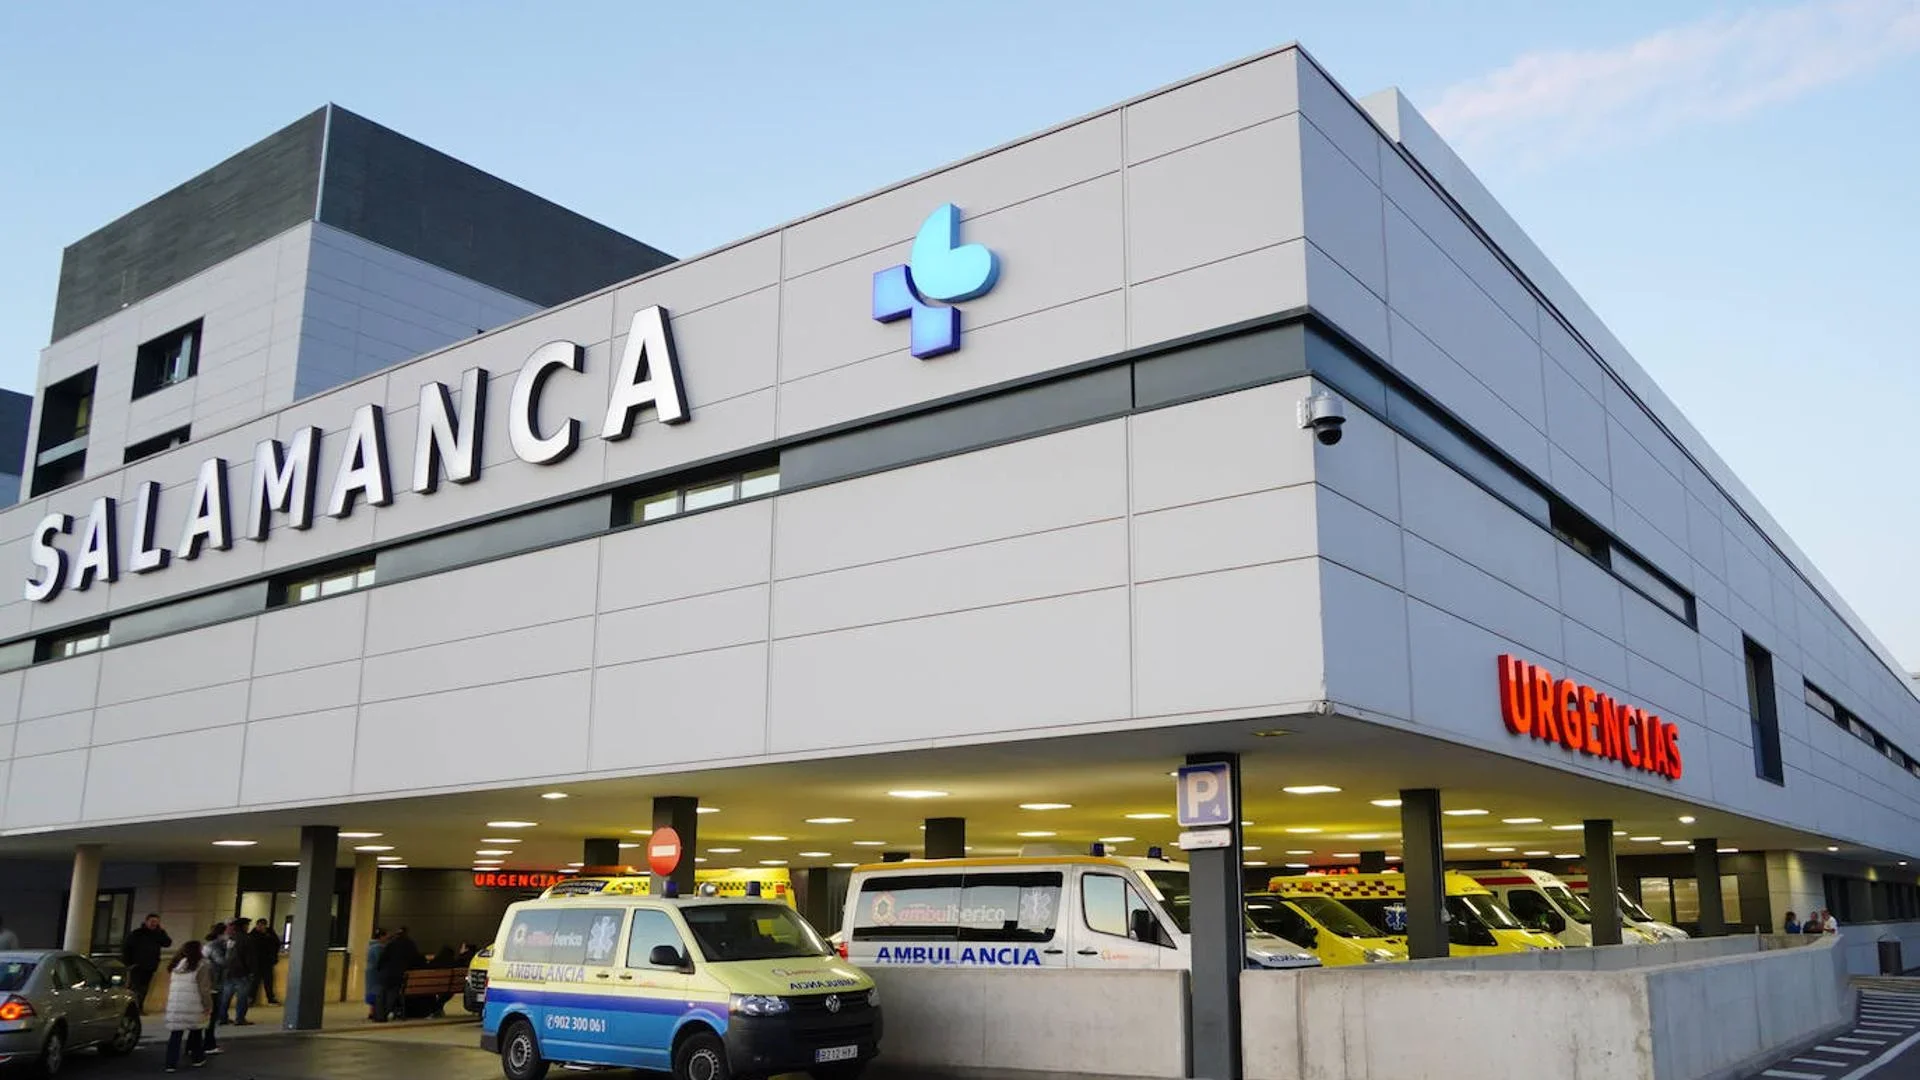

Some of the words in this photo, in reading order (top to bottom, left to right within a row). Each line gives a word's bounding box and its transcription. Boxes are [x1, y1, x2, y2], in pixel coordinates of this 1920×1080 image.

[25, 304, 691, 602] SALAMANCA
[1498, 654, 1682, 780] URGENCIAS
[1187, 770, 1219, 818] P
[875, 946, 1041, 965] AMBULANCIA
[505, 963, 585, 983] AMBULANCIA
[554, 1015, 570, 1029] 902
[572, 1016, 588, 1031] 300
[589, 1018, 606, 1033] 061
